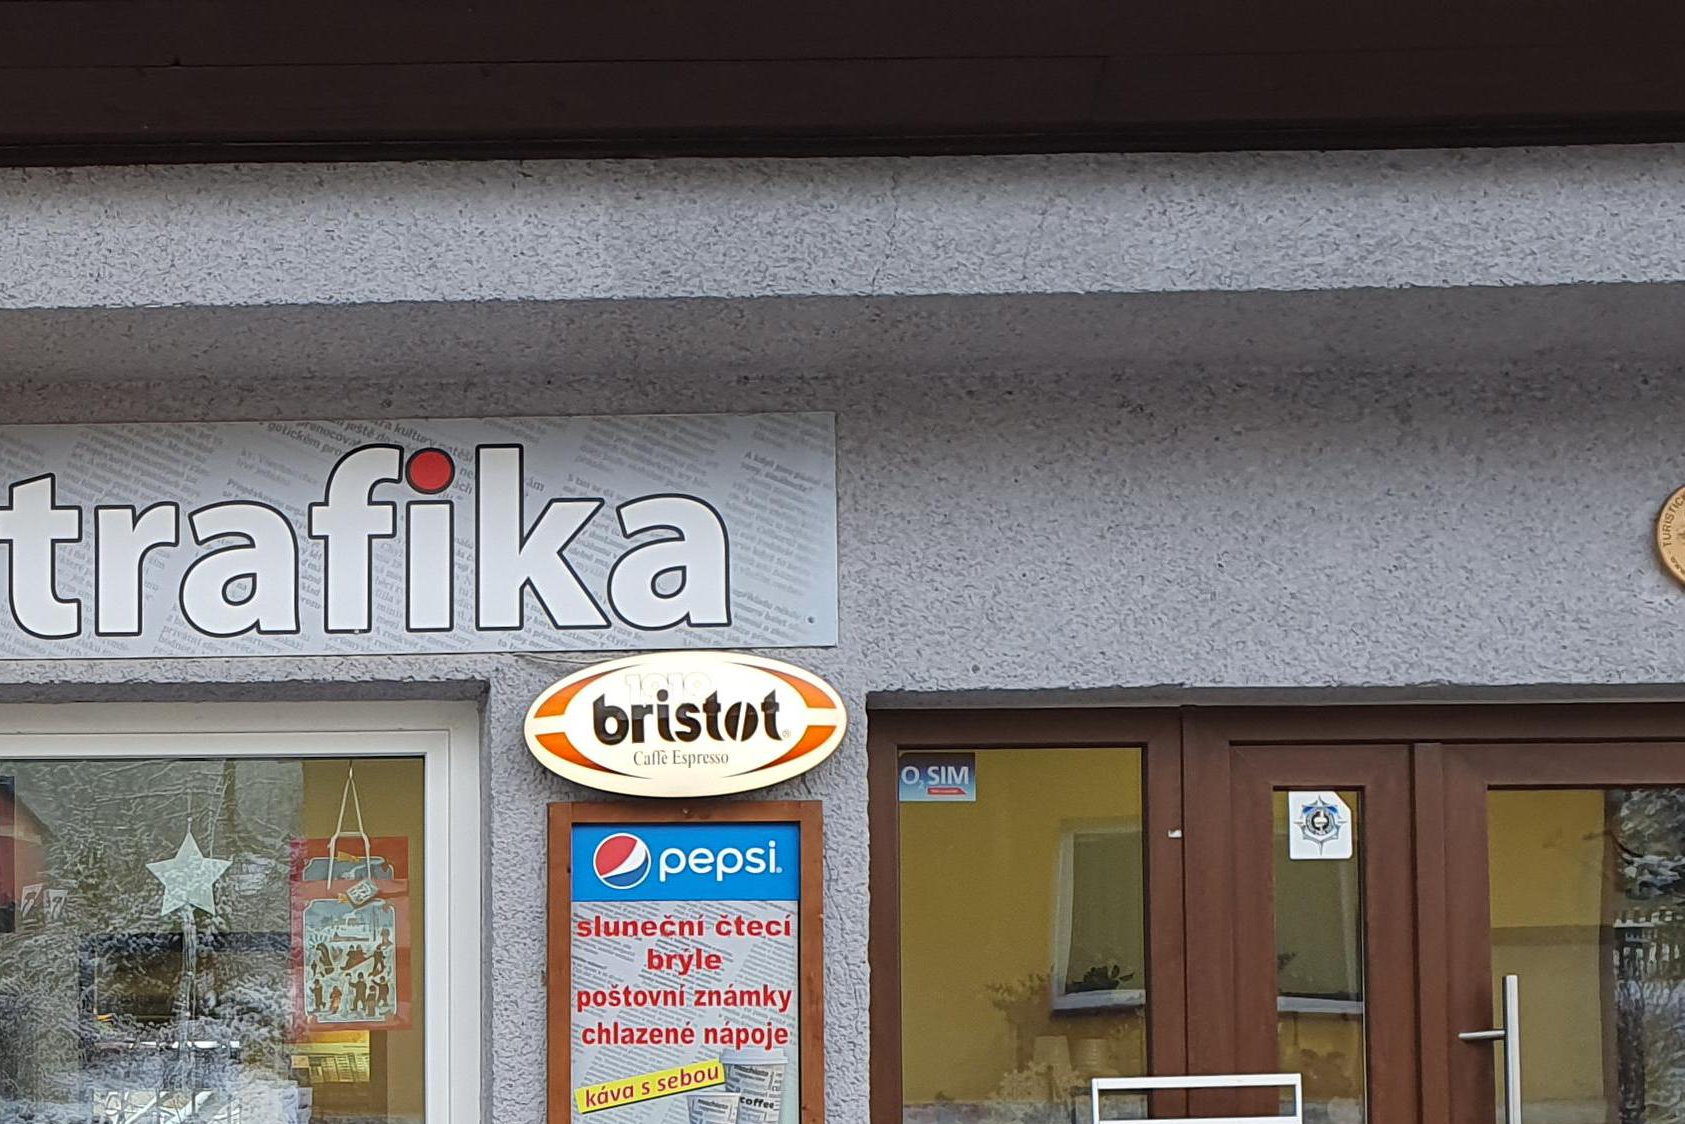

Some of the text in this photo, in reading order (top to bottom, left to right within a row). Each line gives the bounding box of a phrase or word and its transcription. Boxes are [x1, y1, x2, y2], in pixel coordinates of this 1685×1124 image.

[592, 688, 783, 746] bristot
[672, 750, 729, 769] Espresso
[927, 766, 970, 785] SIM
[659, 840, 777, 883] pepsi
[576, 914, 792, 938] sluneční čtecí
[647, 948, 723, 976] brýle
[577, 984, 793, 1013] poštovní známky
[581, 1021, 789, 1051] chlazené nápoje
[585, 1084, 634, 1108] káva
[641, 1079, 651, 1096] s
[657, 1065, 719, 1092] sebou
